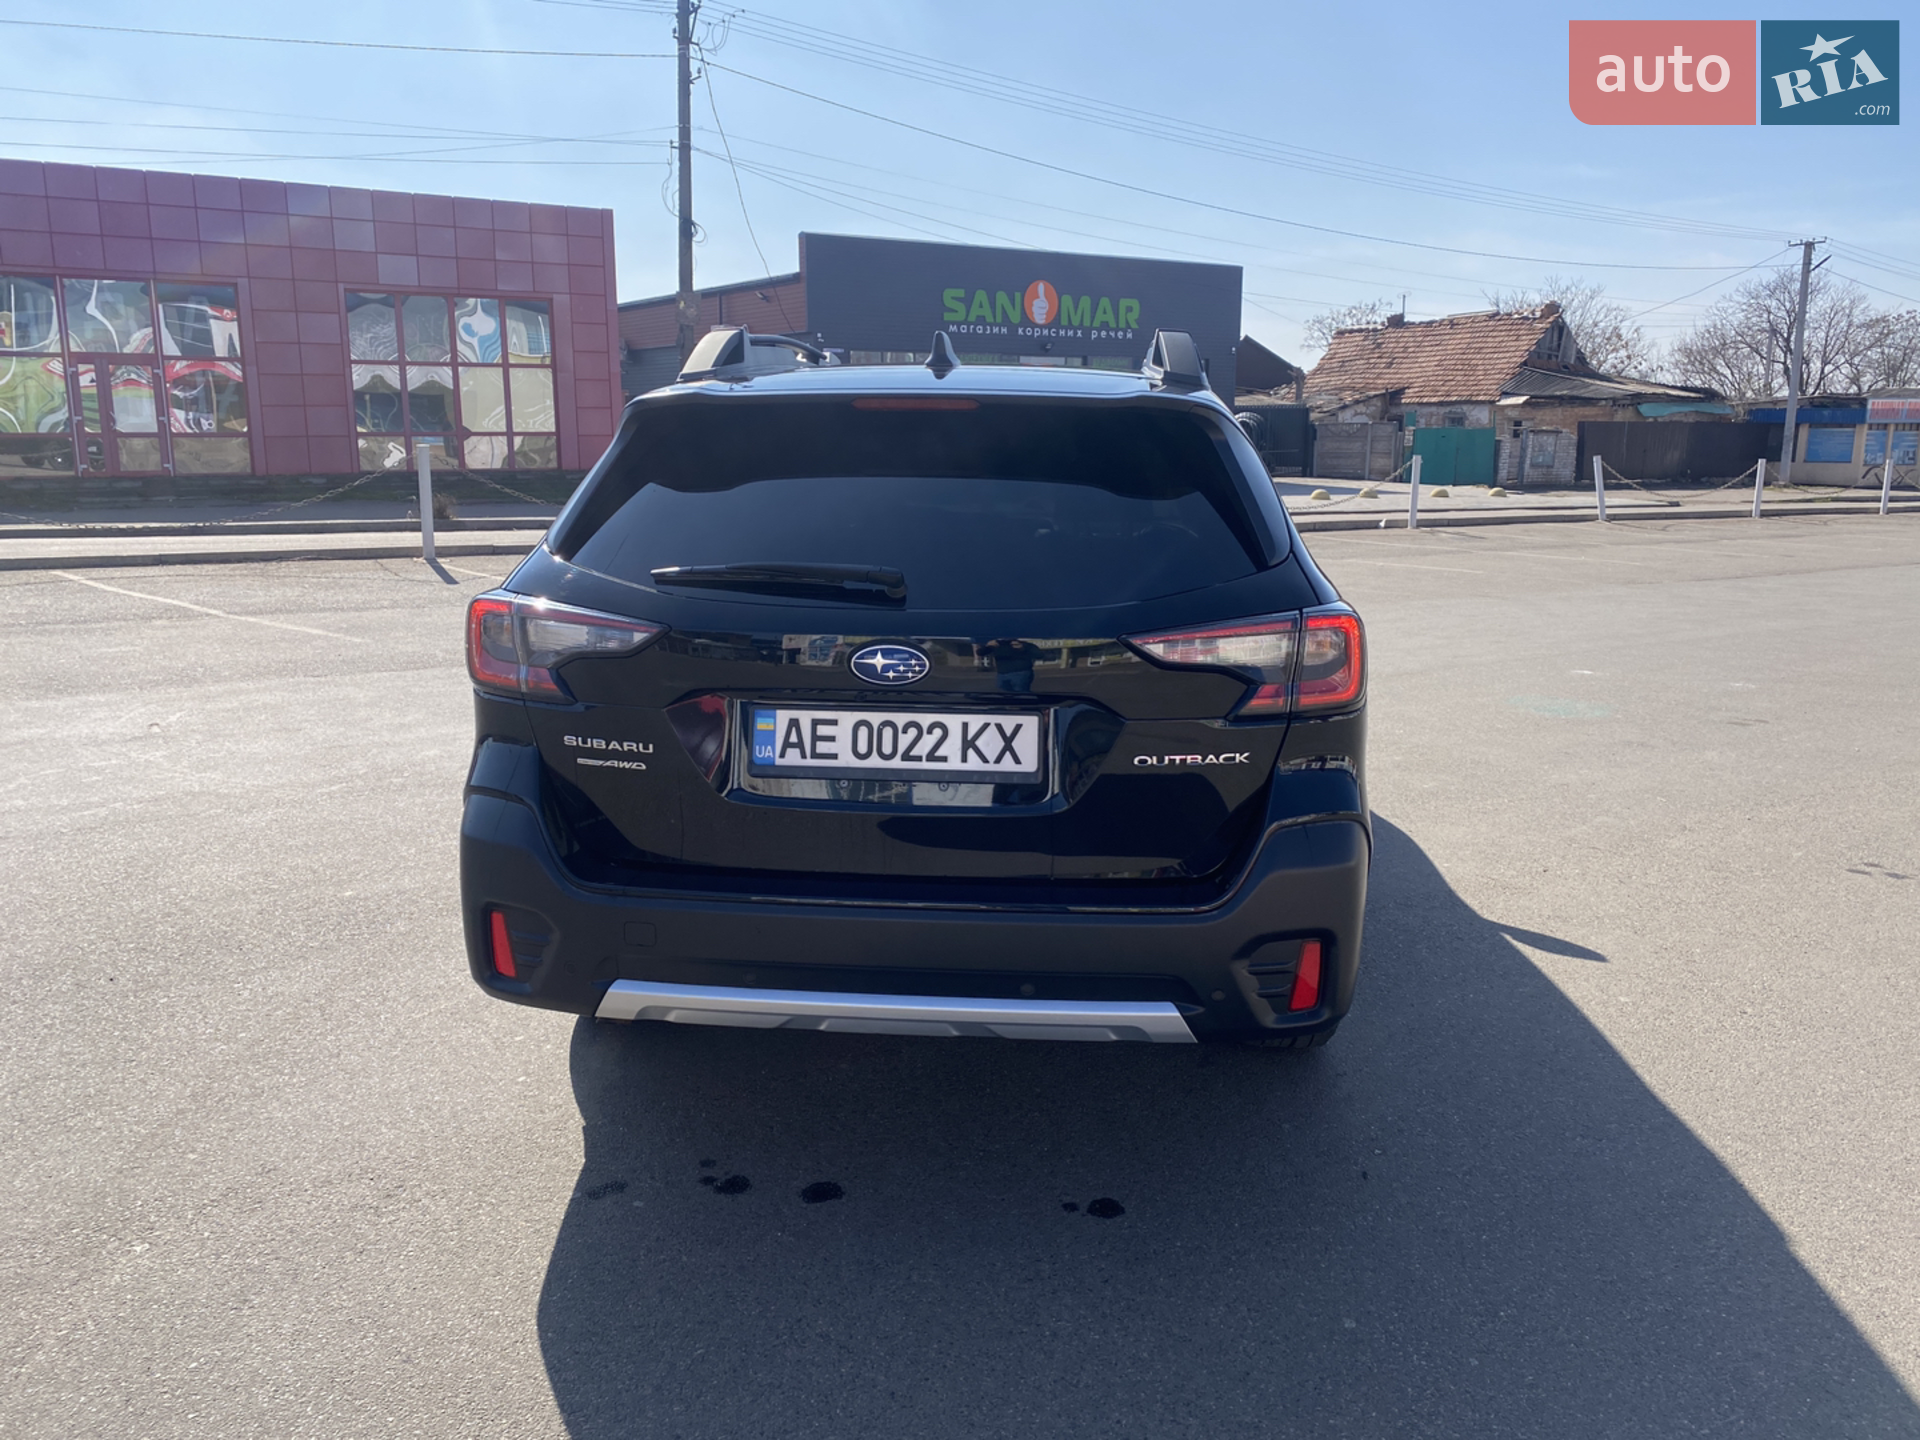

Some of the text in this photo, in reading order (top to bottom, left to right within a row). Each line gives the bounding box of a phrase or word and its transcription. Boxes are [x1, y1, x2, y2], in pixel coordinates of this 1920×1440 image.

[948, 323, 1133, 340] магазин корисних речей
[563, 735, 653, 753] SUBARU
[778, 717, 1024, 765] AE 0022 KX
[755, 745, 774, 759] UA
[1133, 752, 1250, 767] OUTBACK
[602, 760, 646, 770] AWD
